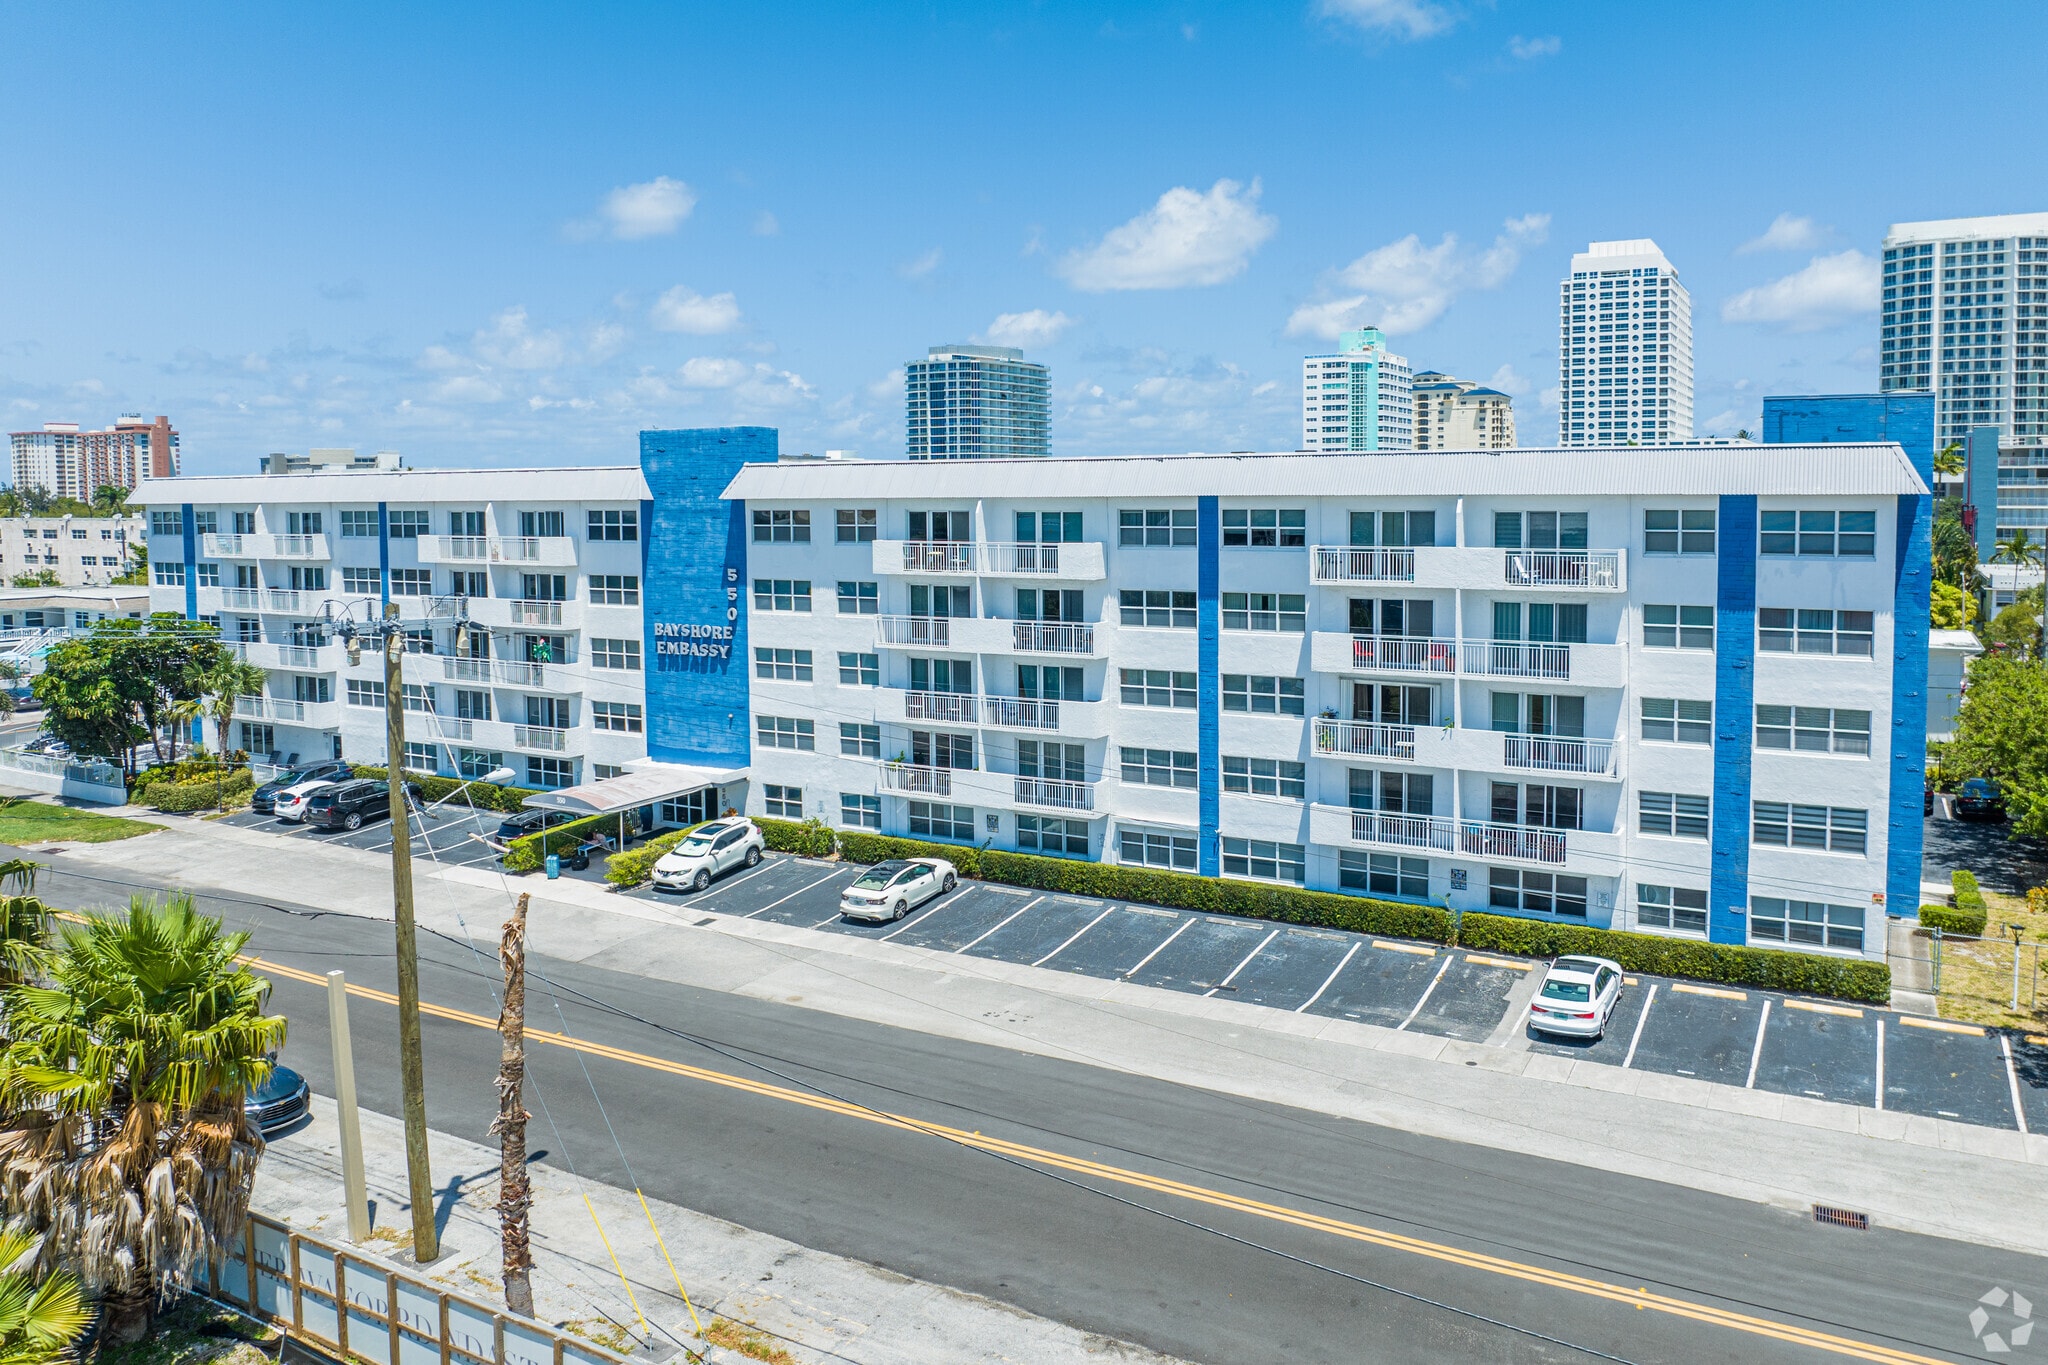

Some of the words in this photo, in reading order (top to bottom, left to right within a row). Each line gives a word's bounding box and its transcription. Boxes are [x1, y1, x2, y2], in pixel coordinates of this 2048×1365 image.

[727, 568, 738, 621] 550
[654, 622, 733, 640] BAYSHORE
[656, 641, 730, 659] EMBASSY
